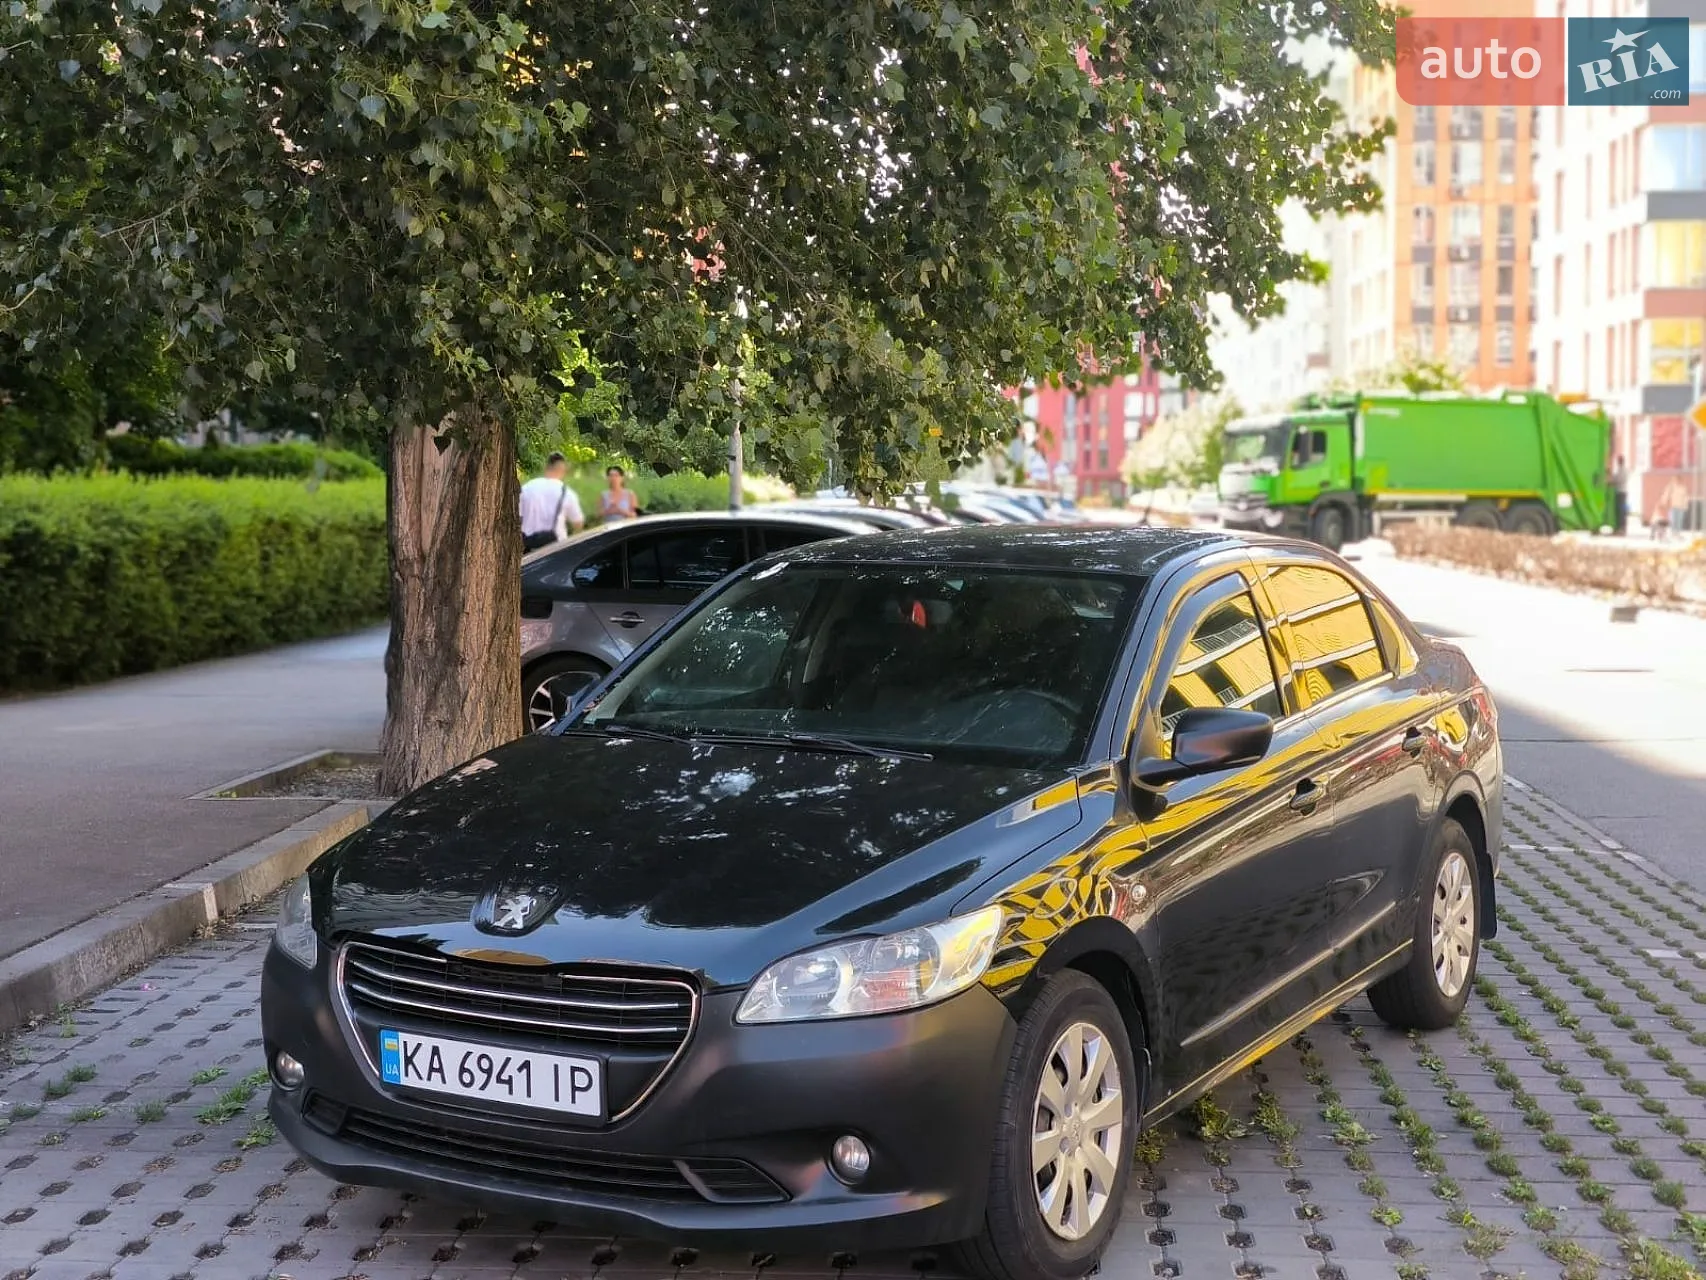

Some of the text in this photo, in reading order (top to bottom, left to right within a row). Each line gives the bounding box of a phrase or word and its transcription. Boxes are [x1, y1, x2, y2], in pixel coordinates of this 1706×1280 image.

[385, 1062, 399, 1076] UA
[402, 1040, 594, 1104] KA 6941 IP
